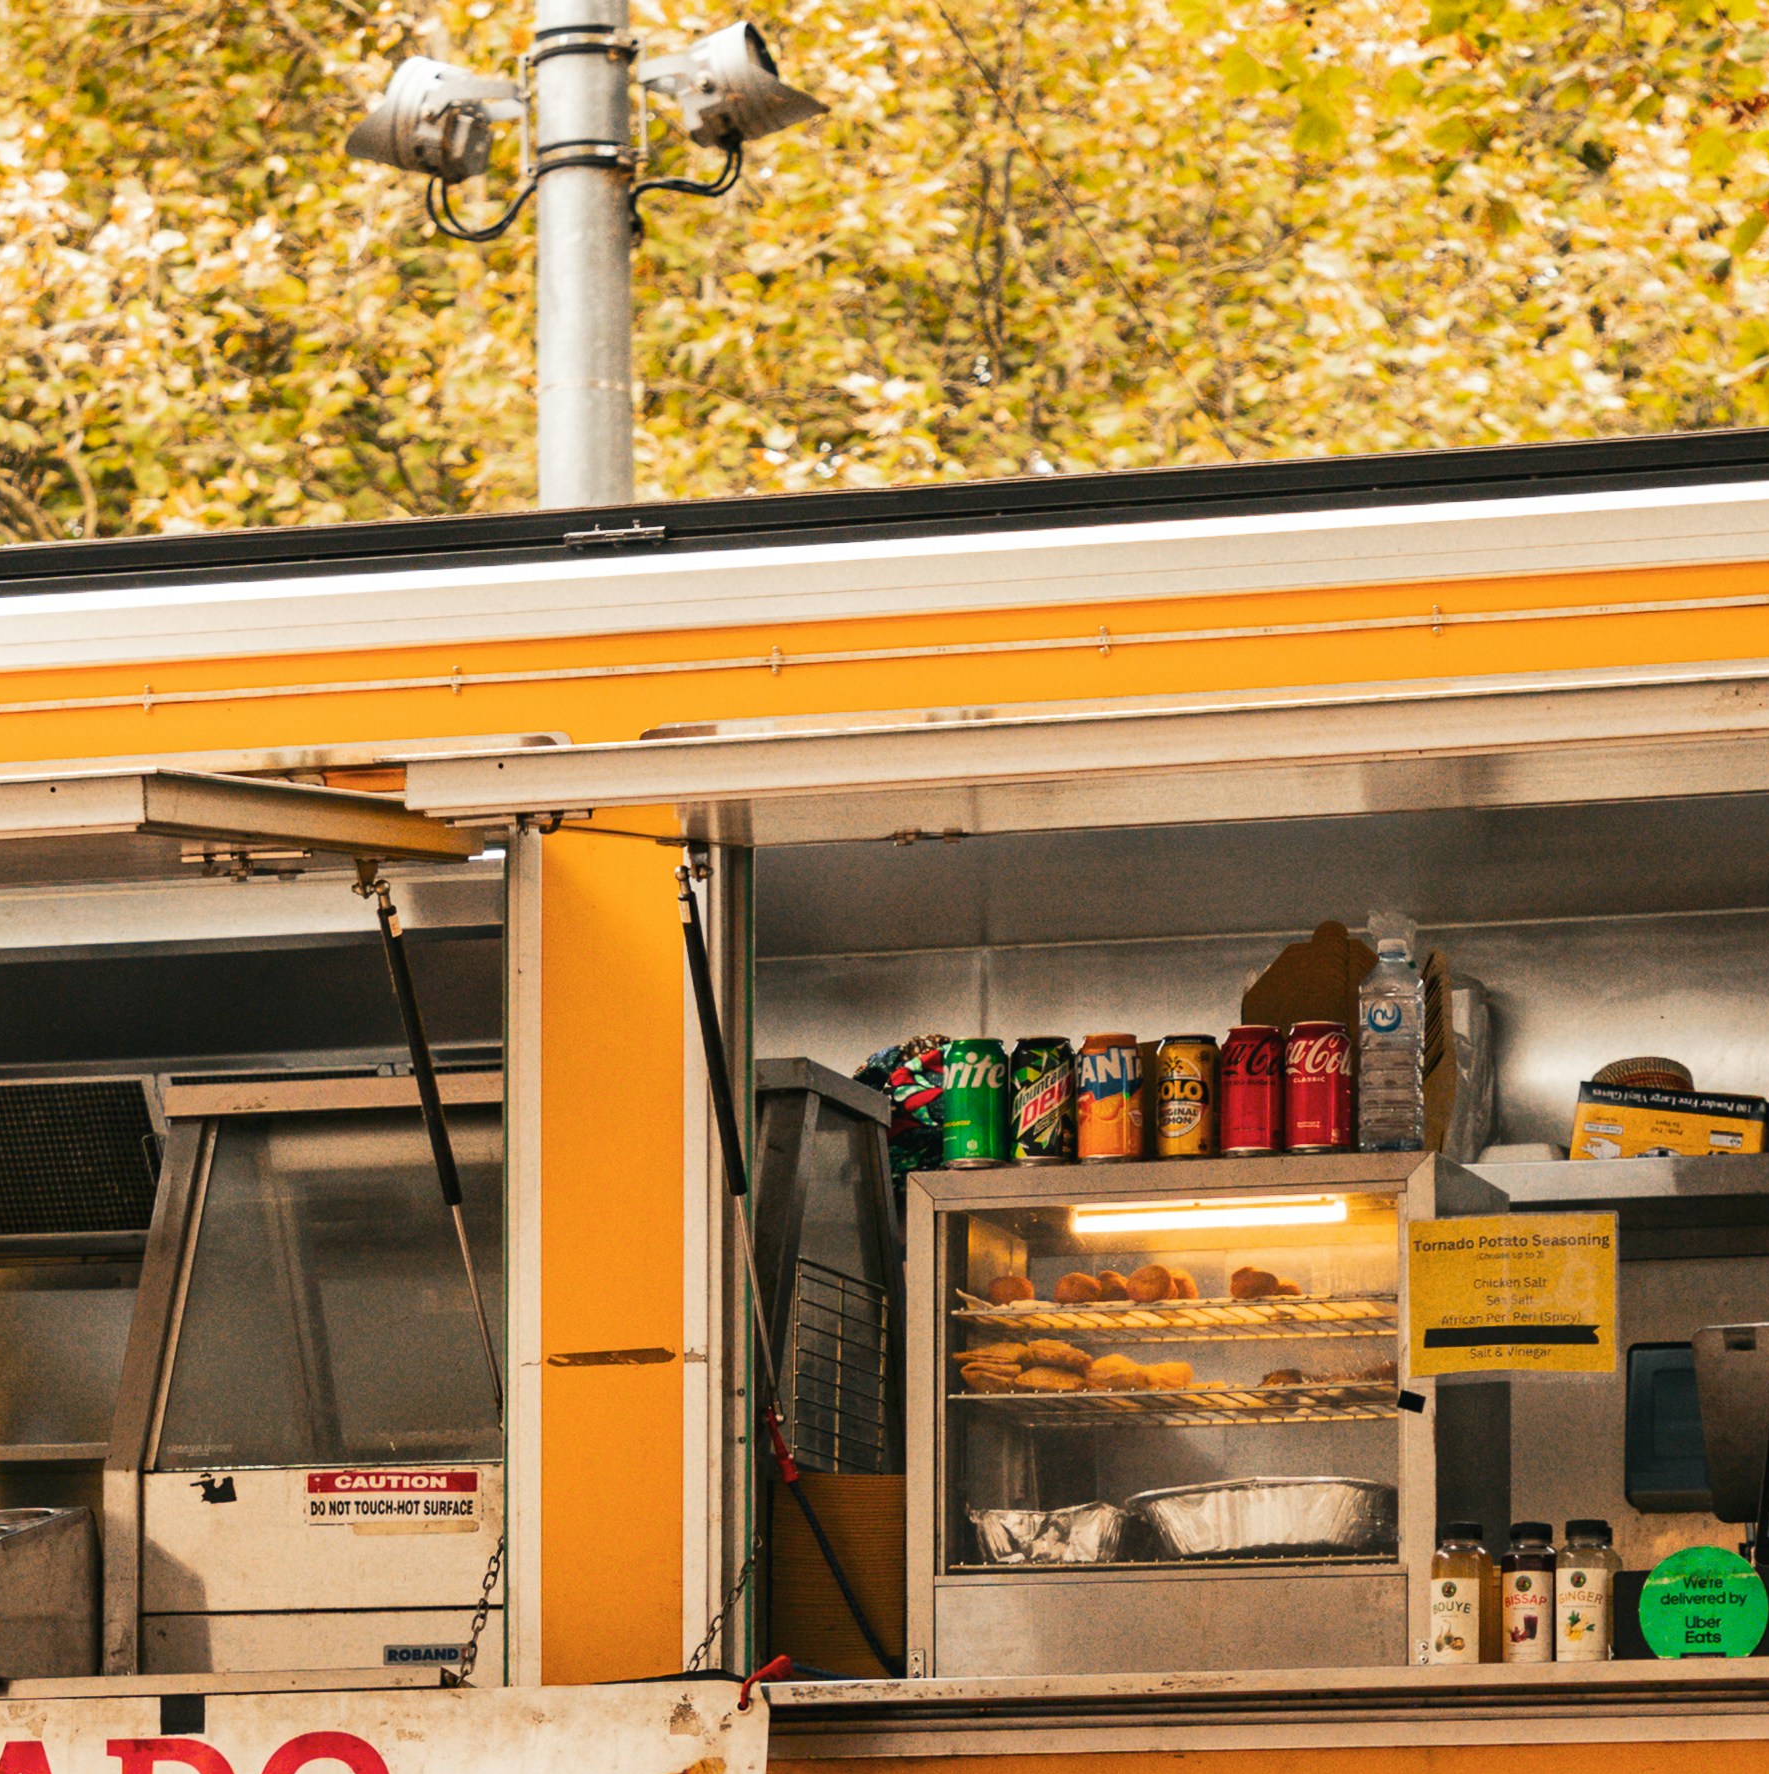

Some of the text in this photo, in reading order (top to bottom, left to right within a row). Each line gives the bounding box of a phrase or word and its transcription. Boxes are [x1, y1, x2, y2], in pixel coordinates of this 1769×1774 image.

[1161, 1080, 1203, 1100] OLO
[1413, 1233, 1610, 1253] Tornado Potato Seasoning
[334, 1475, 448, 1489] CAUTION
[310, 1500, 474, 1515] DO NOT TOUCH-HOT SURFACE
[1683, 1575, 1725, 1590] We're
[1504, 1593, 1547, 1608] BISSAP
[1558, 1590, 1604, 1605] GINGER
[1660, 1591, 1748, 1608] delivered by
[1685, 1615, 1722, 1628] Uber
[1685, 1630, 1722, 1644] Eats
[386, 1647, 459, 1662] ROBAND
